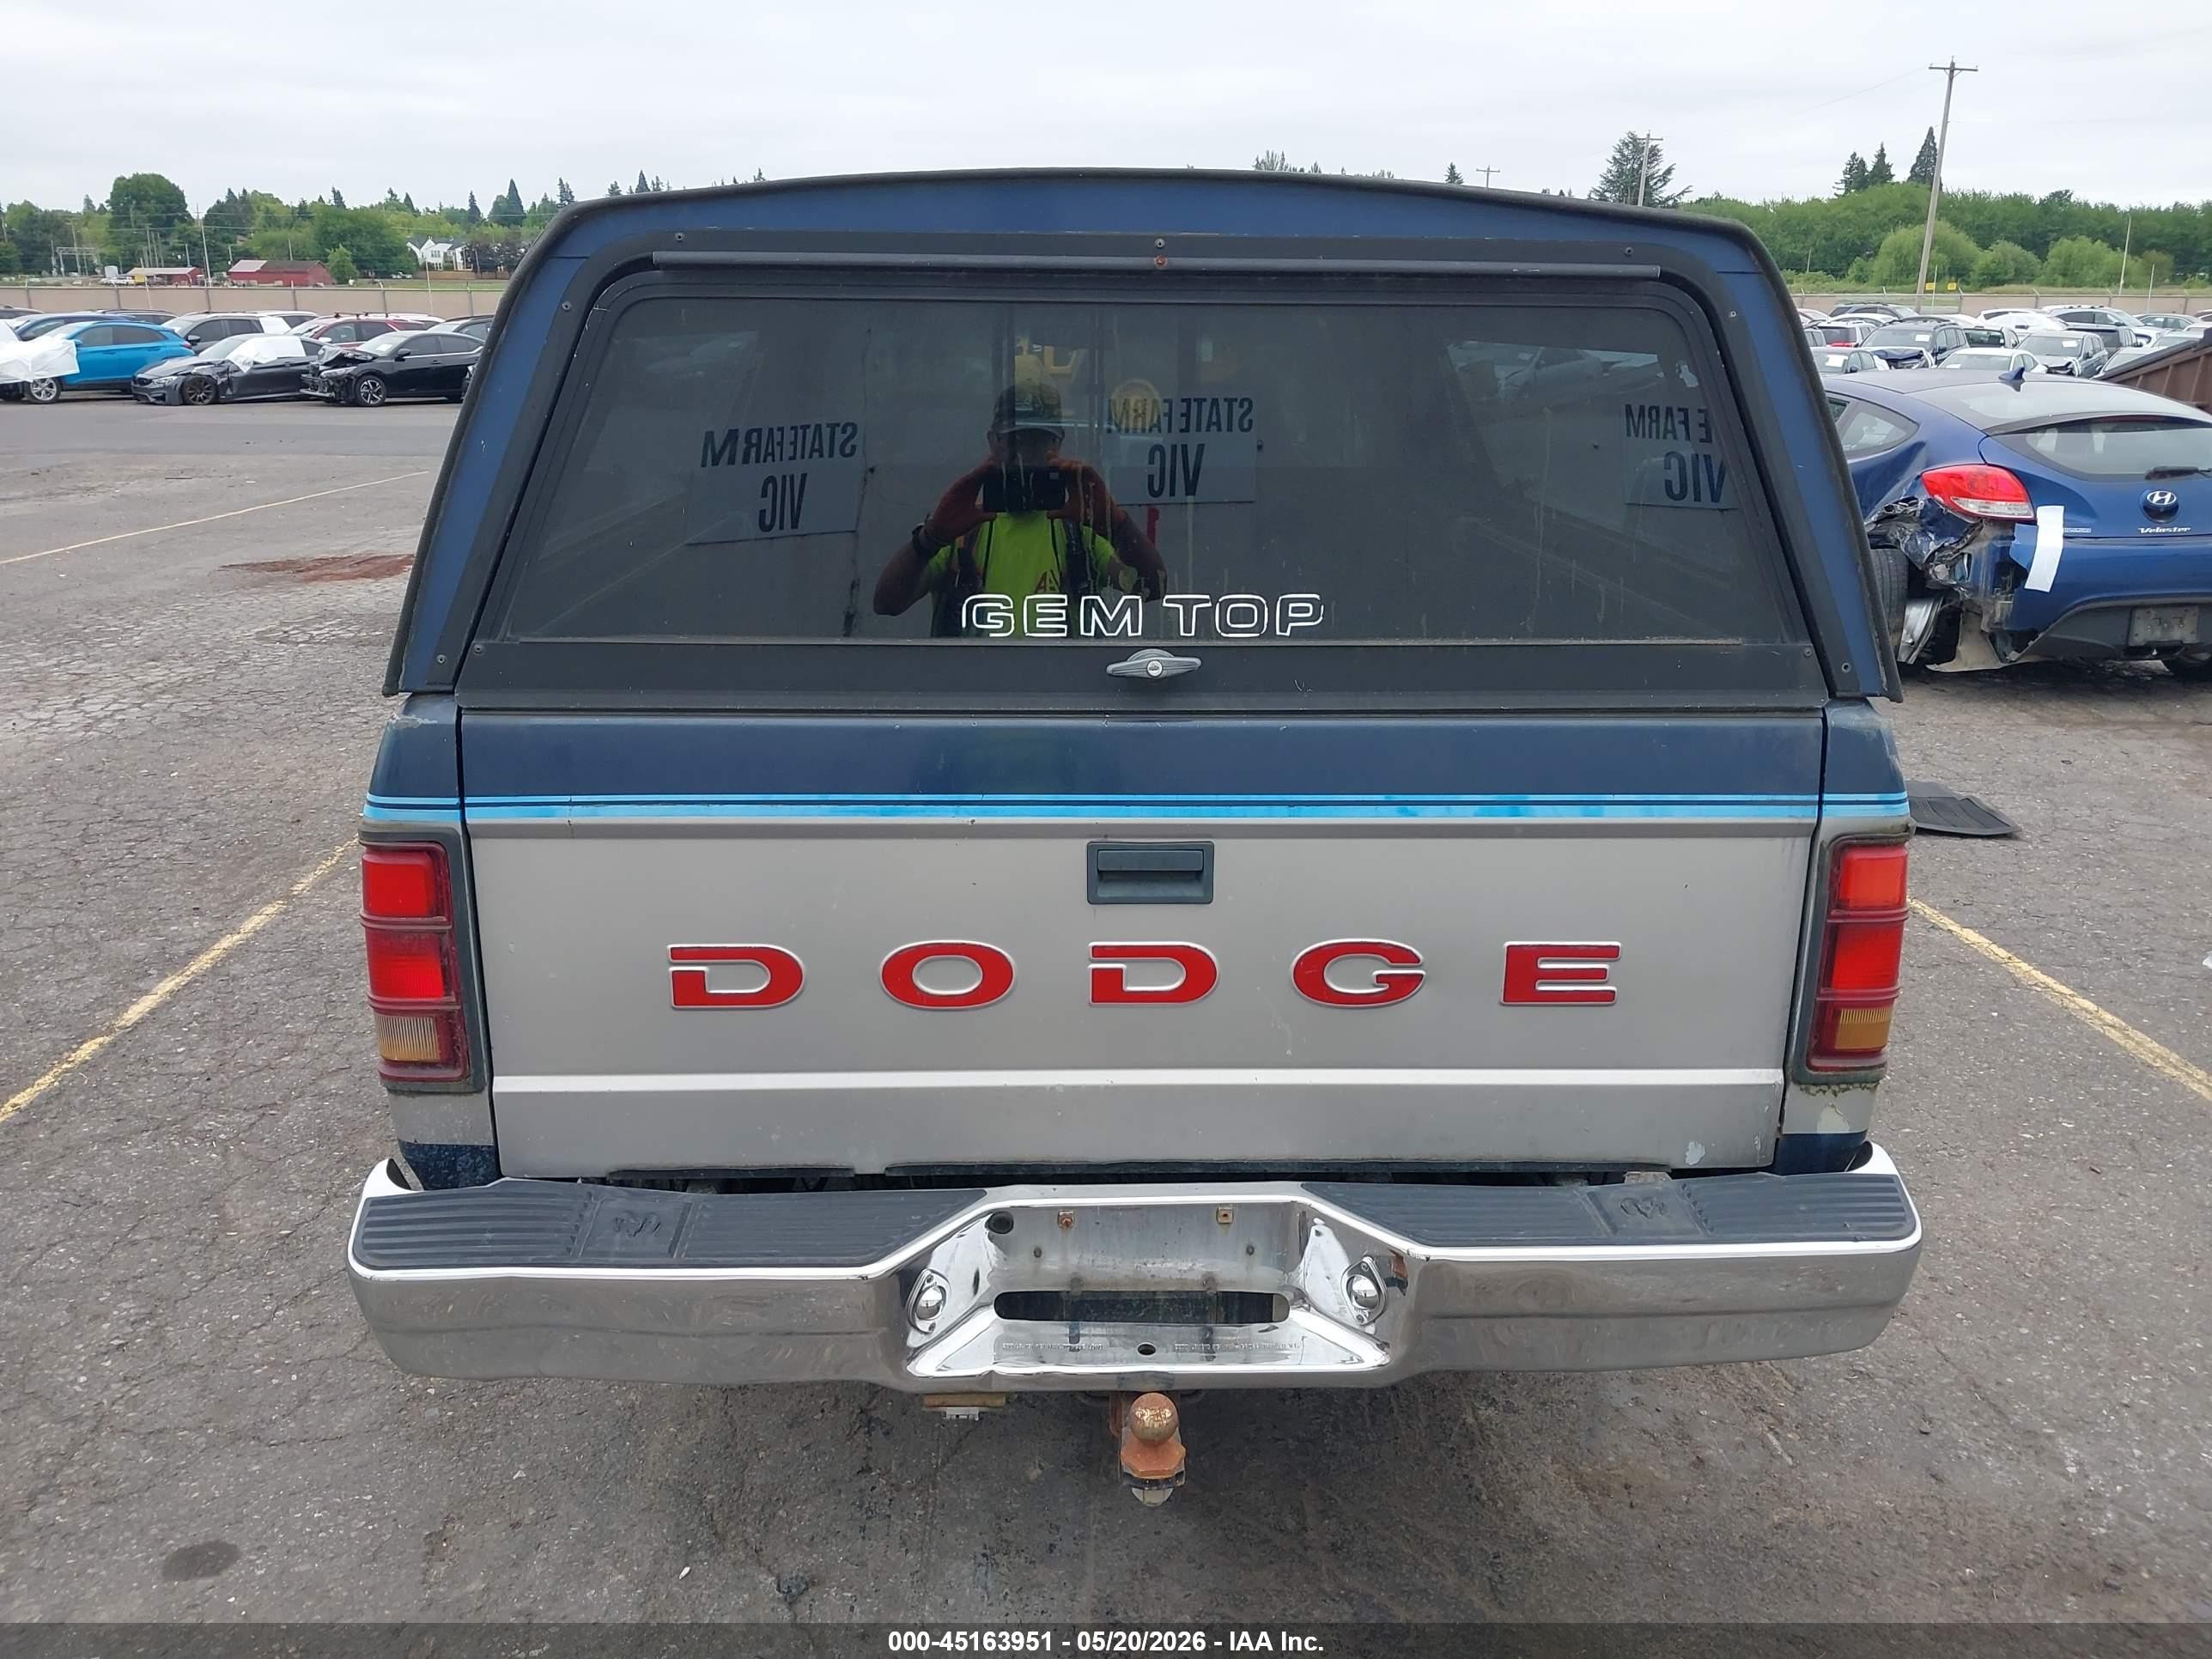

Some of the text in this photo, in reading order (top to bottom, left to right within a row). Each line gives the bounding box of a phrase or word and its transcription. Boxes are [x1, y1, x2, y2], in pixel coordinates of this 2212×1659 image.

[2136, 526, 2191, 534] Veloster
[961, 593, 1324, 638] GEM TOP
[667, 939, 1621, 1010] DODGE
